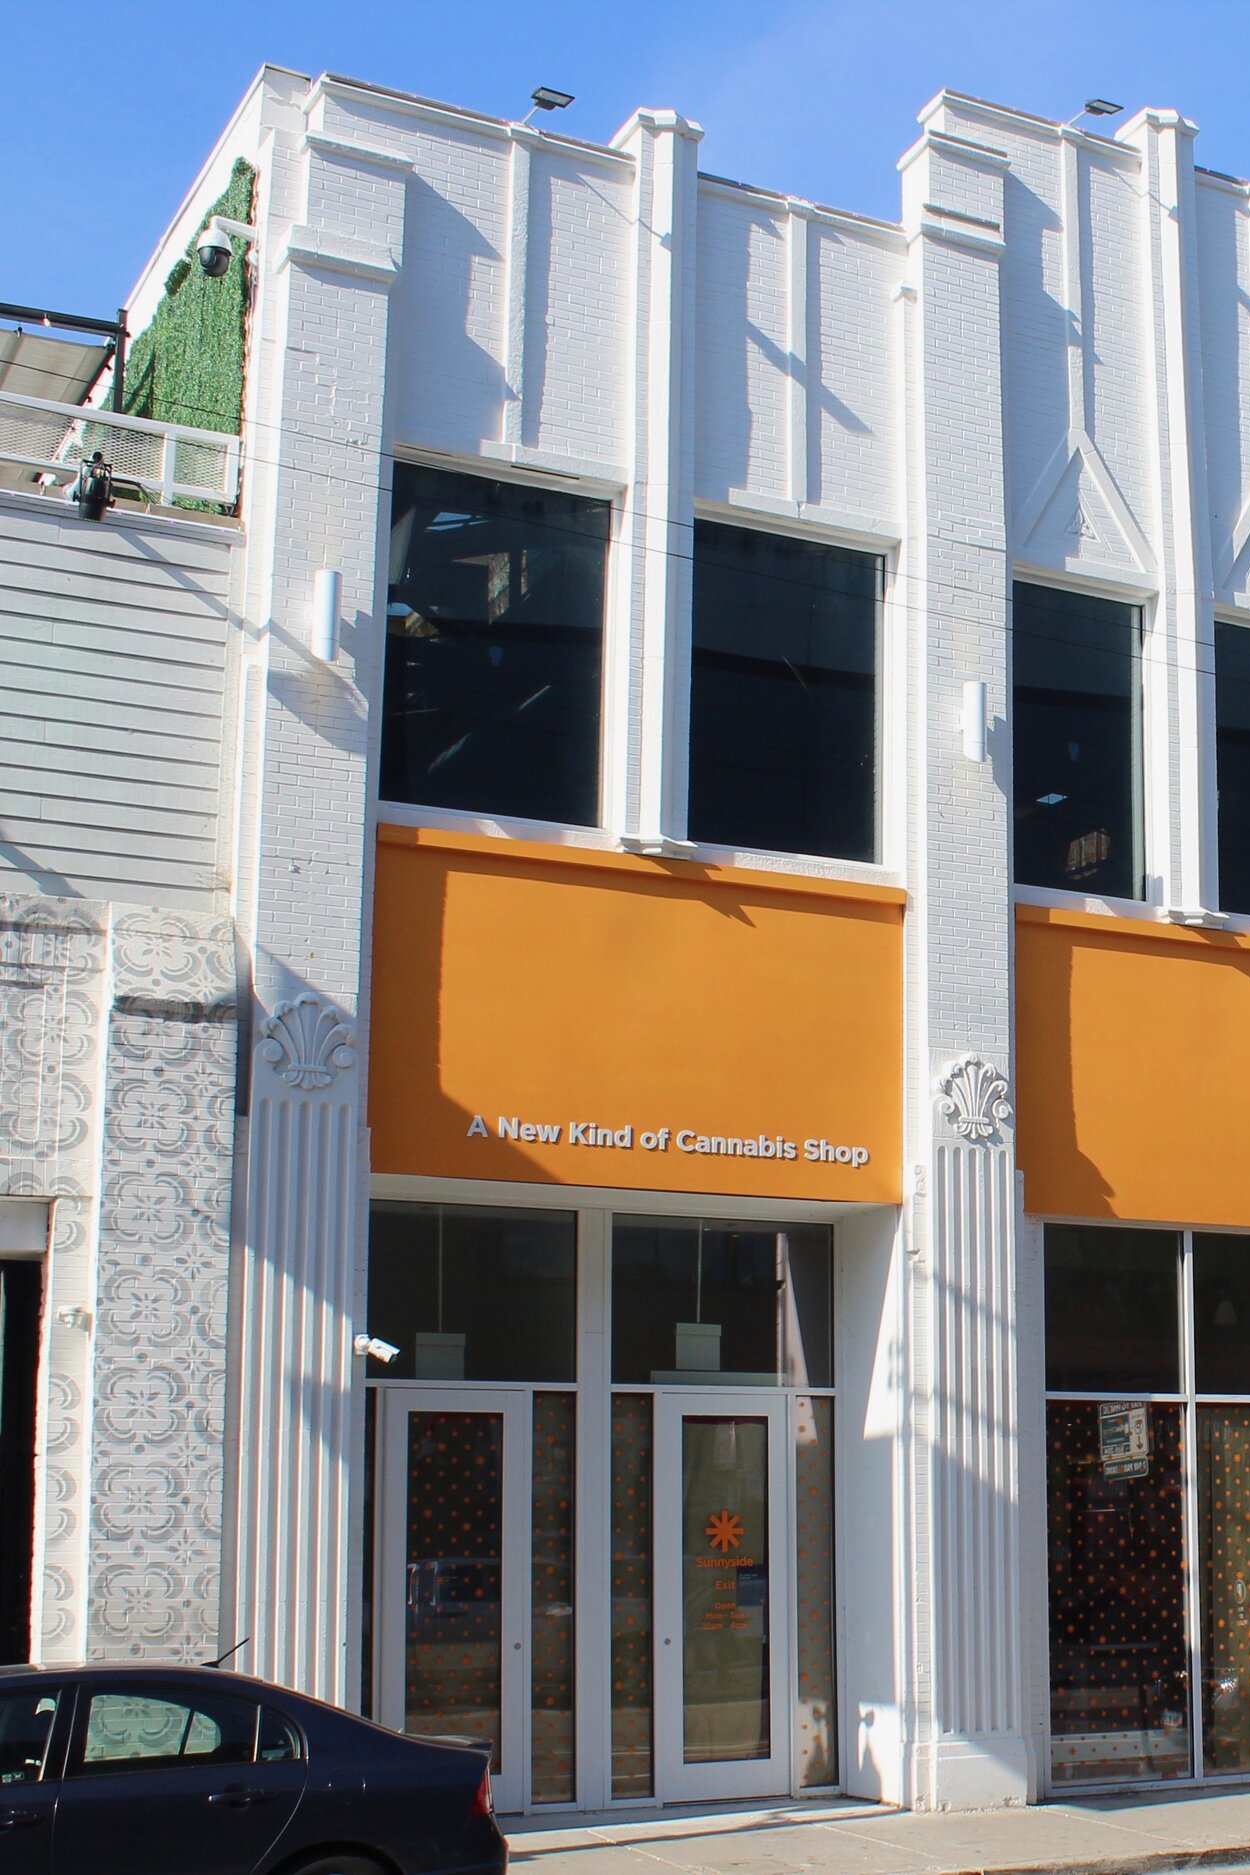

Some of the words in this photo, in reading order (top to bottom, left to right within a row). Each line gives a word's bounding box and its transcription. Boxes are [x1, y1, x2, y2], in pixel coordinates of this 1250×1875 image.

[467, 1114, 488, 1138] A
[498, 1116, 561, 1145] New
[569, 1121, 632, 1149] Kind
[640, 1127, 671, 1151] of
[676, 1130, 797, 1159] Cannabis
[804, 1140, 870, 1168] Shop
[696, 1556, 754, 1569] Sunnyside
[716, 1581, 736, 1590] Exit
